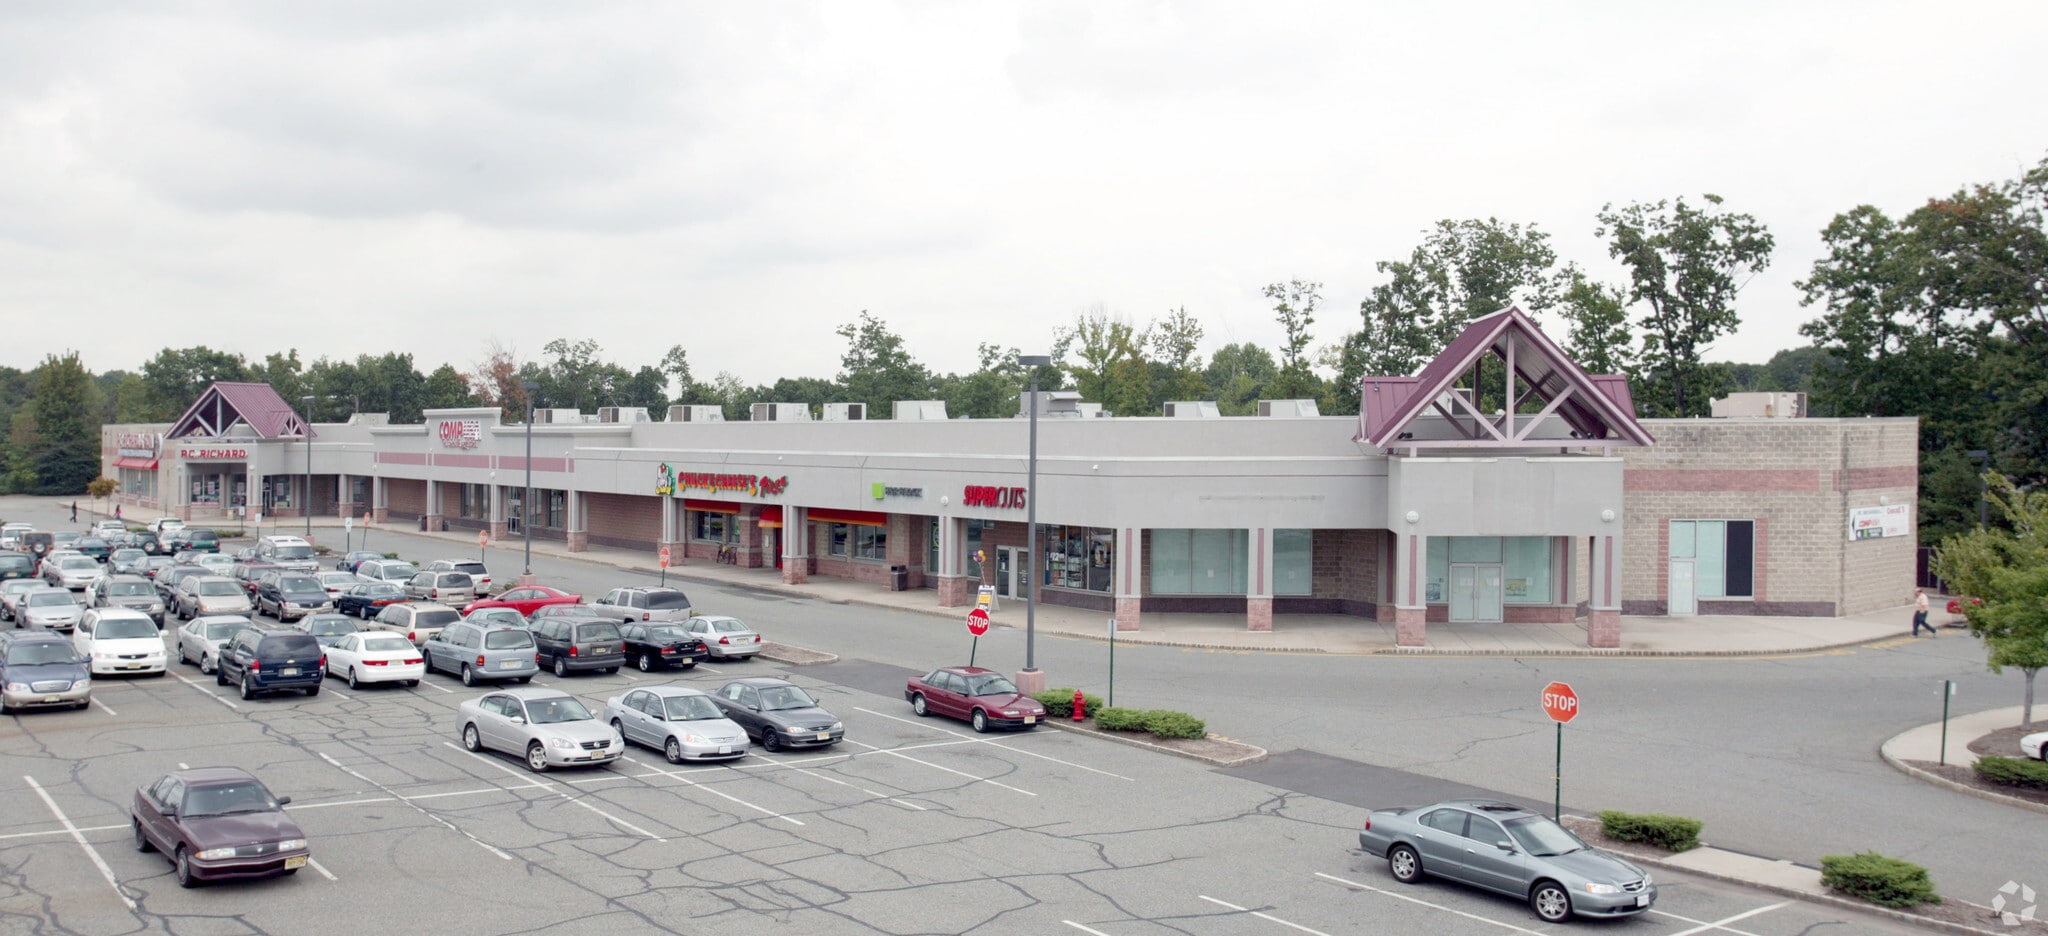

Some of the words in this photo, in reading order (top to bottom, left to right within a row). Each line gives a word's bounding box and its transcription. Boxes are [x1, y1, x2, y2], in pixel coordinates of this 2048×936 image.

[200, 449, 248, 459] RICHARD
[678, 471, 708, 492] CHUCK
[968, 615, 988, 628] STOP
[1544, 693, 1576, 712] STOP
